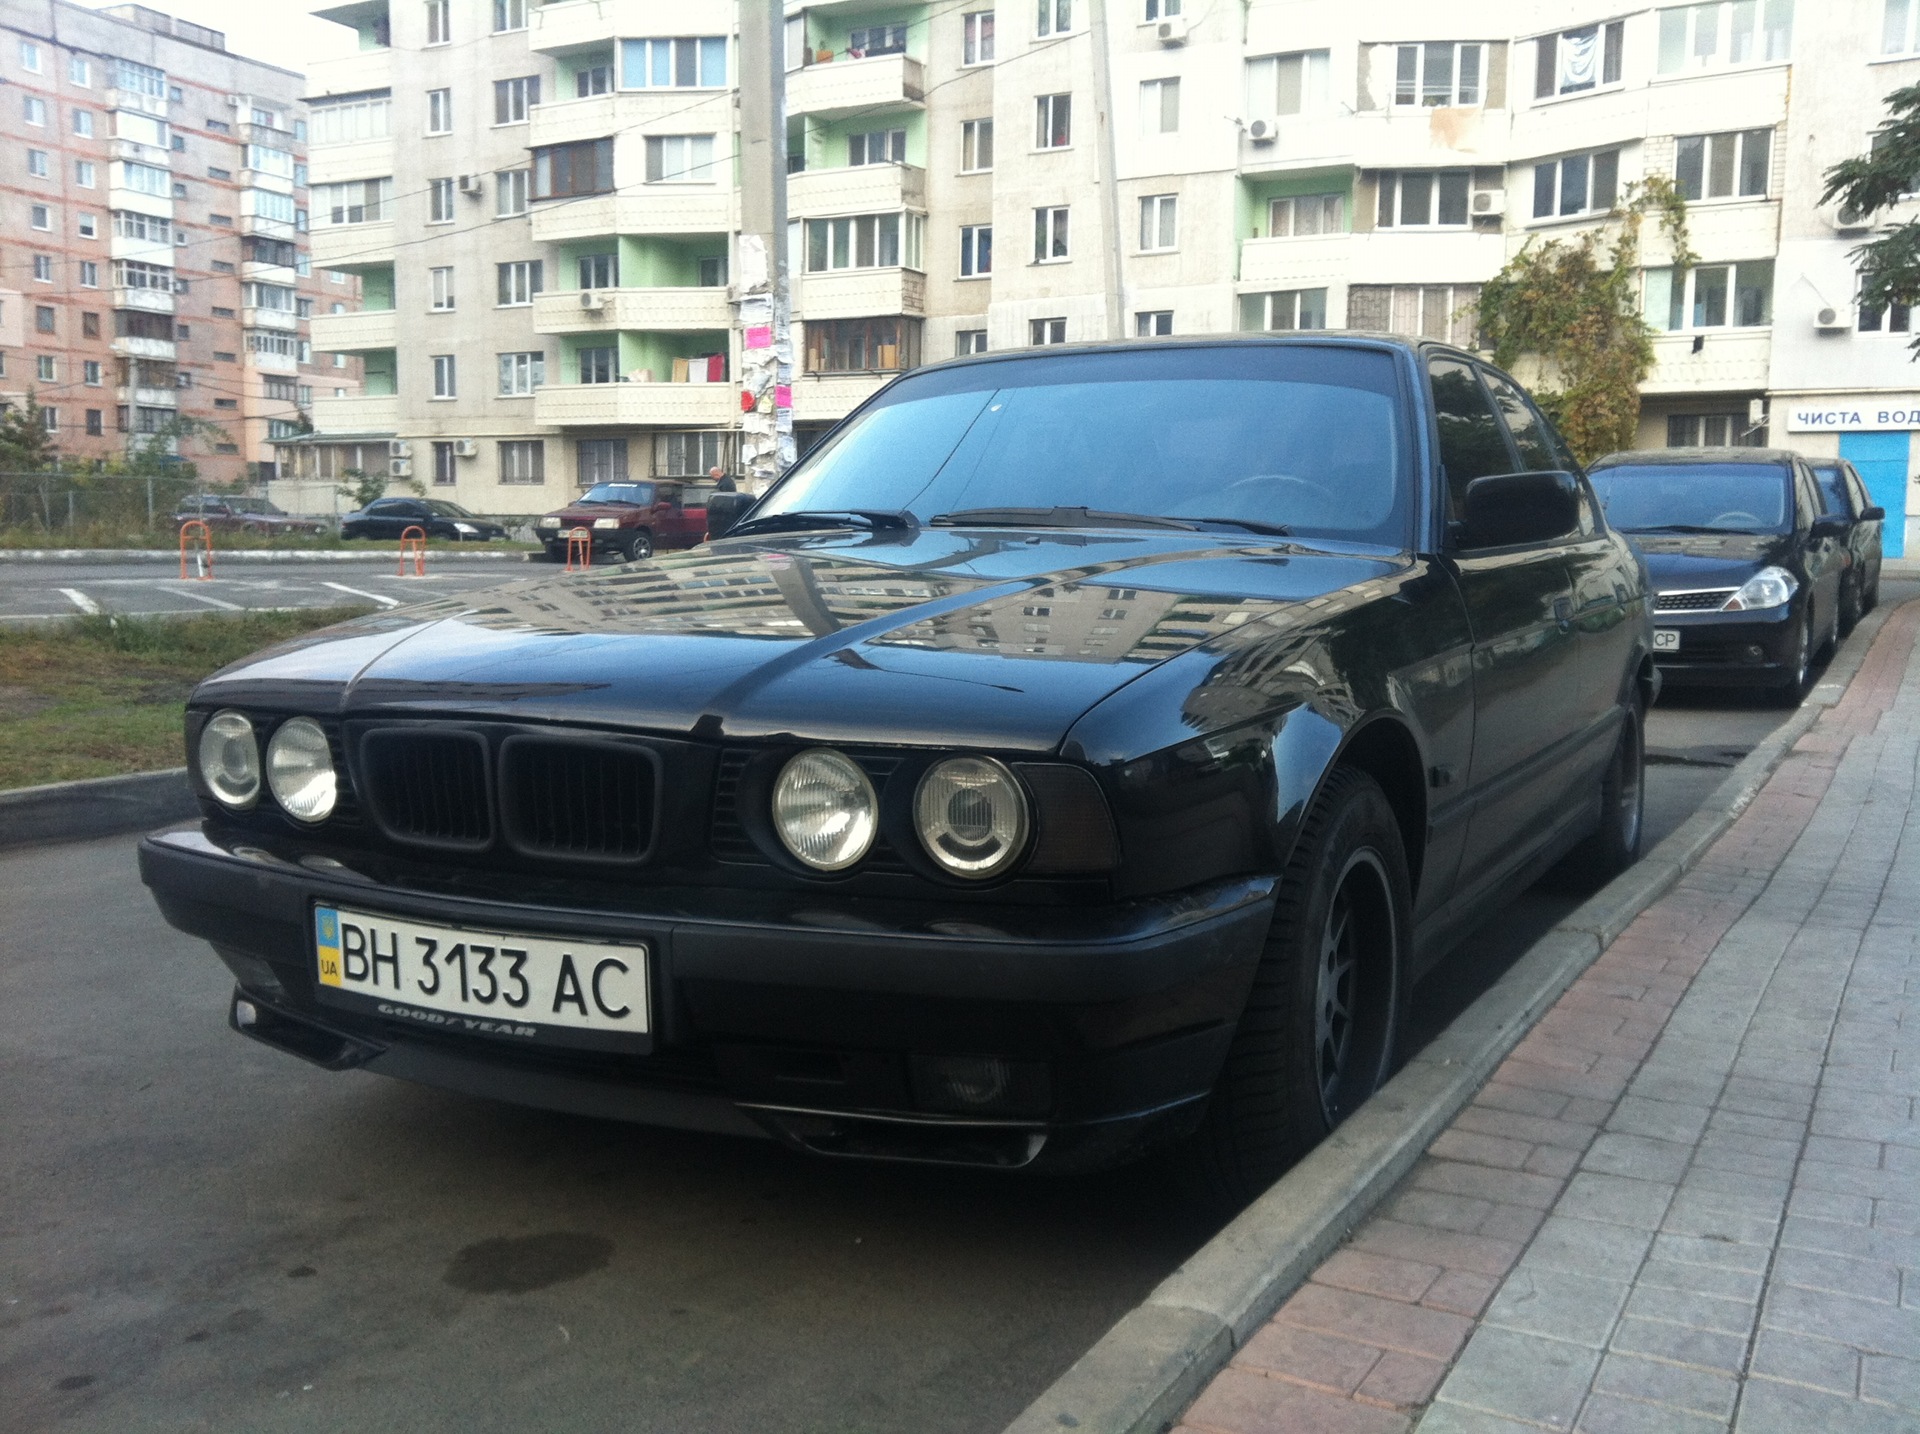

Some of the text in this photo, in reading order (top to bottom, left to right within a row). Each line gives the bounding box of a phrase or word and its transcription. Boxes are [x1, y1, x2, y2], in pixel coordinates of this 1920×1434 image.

[1797, 411, 1862, 425] ЧИСТА
[1654, 633, 1676, 647] CP
[321, 959, 338, 977] UA
[341, 923, 631, 1020] BH 3133 AC
